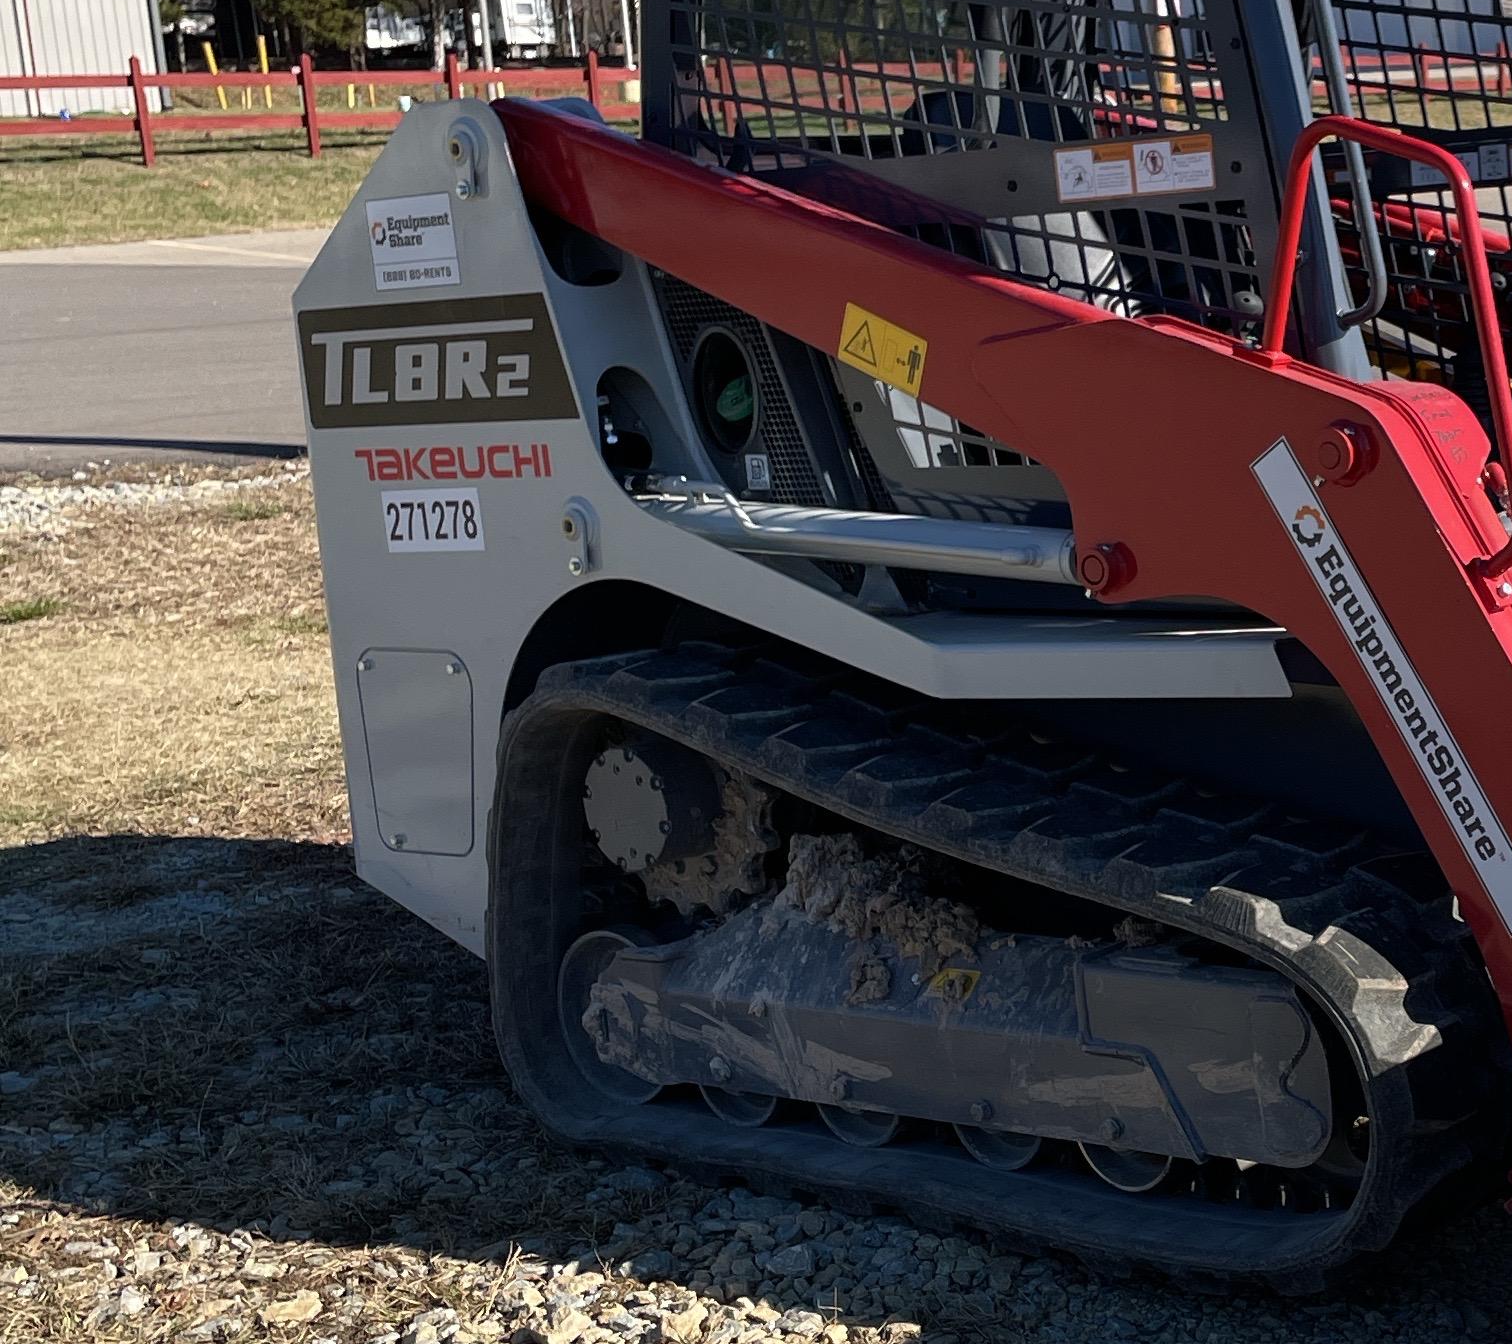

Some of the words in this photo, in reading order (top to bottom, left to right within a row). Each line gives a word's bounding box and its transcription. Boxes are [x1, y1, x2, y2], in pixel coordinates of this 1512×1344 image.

[387, 213, 450, 233] Equipment
[389, 233, 422, 248] Share
[311, 318, 533, 406] TL8R2
[386, 499, 477, 542] 271278
[1315, 544, 1496, 862] EquipmentShare
